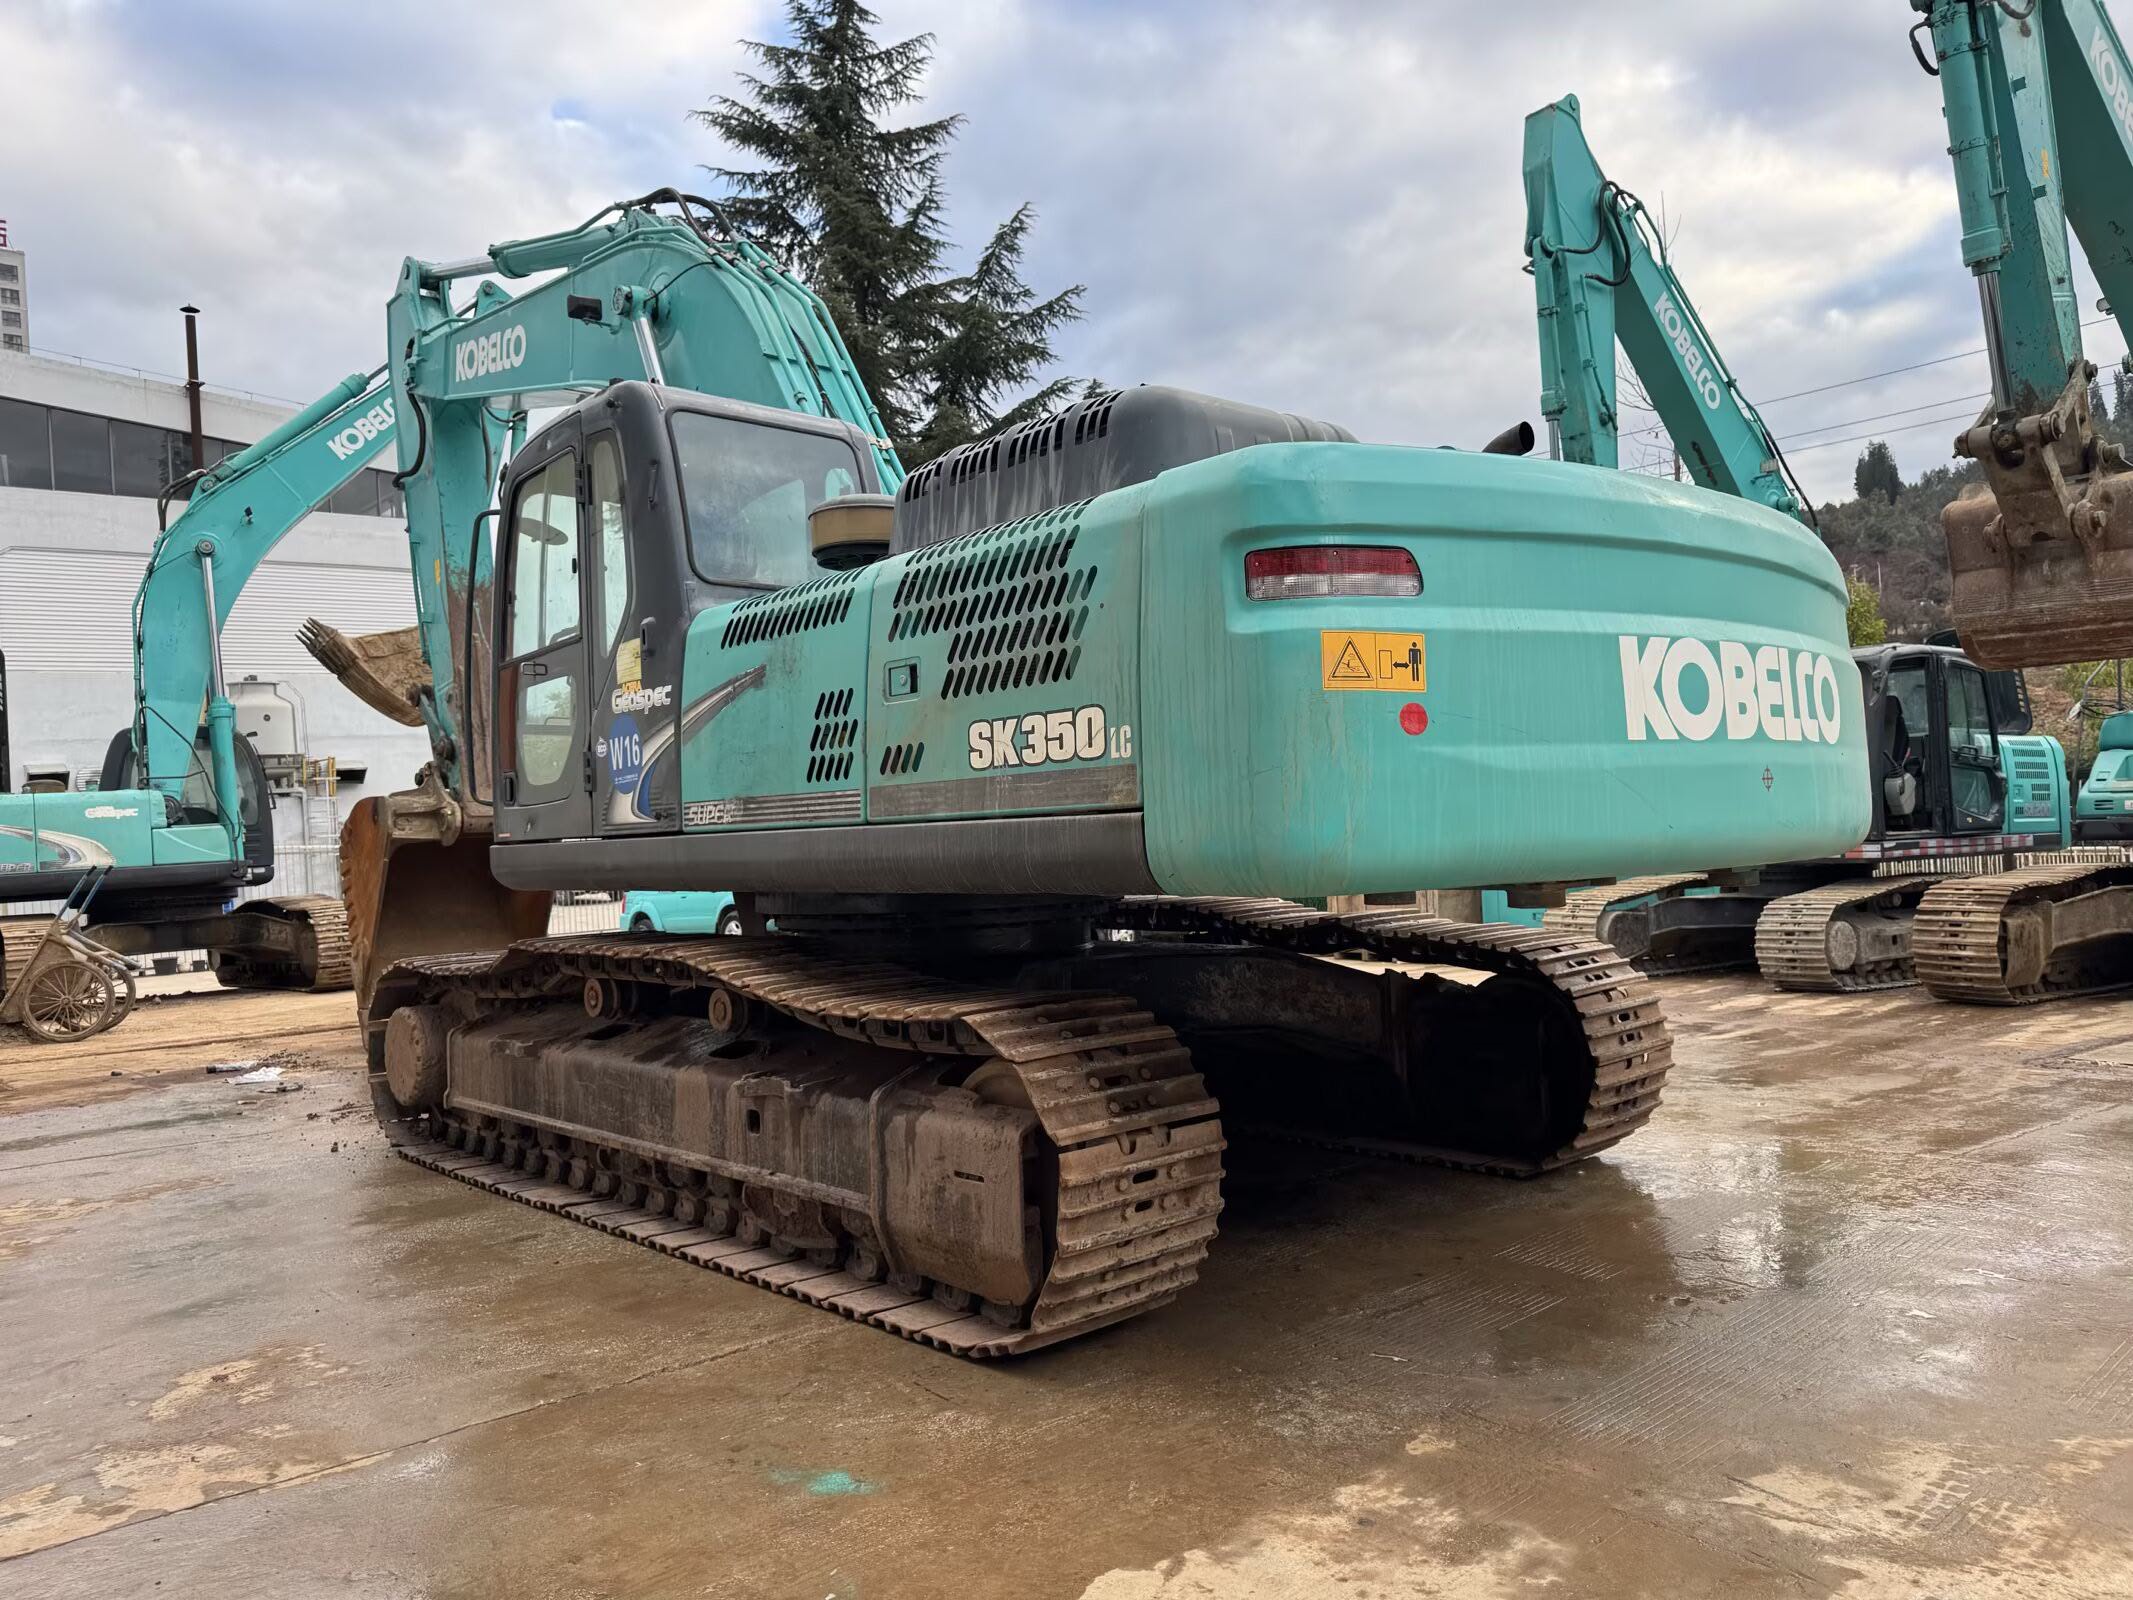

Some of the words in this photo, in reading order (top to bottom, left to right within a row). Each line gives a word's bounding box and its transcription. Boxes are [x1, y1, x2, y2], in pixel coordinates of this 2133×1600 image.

[455, 324, 527, 382] KOBELCO
[1653, 291, 1721, 411] KOBELCO
[1618, 635, 1841, 745] KOBELCO
[610, 733, 641, 771] W16
[968, 703, 1107, 771] SK350
[1110, 724, 1132, 759] LC
